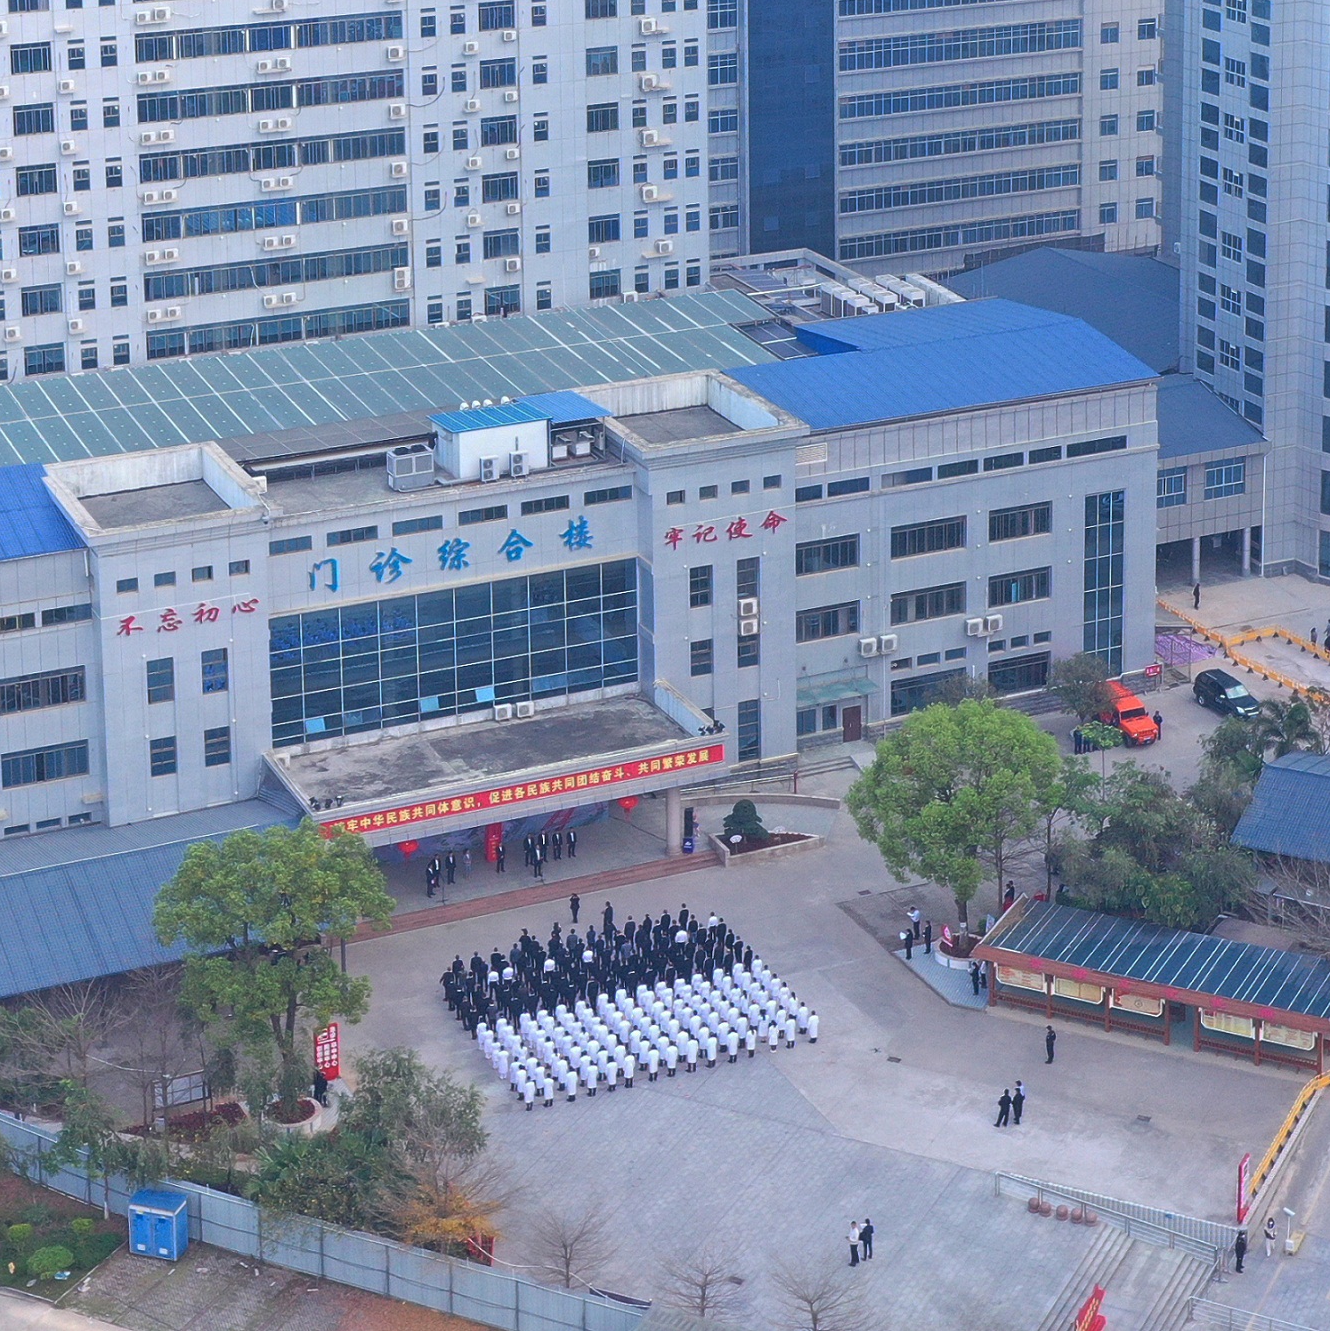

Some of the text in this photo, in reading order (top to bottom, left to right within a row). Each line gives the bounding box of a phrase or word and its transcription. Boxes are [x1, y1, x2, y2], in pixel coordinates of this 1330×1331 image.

[664, 509, 788, 551] 牢记使命
[307, 516, 594, 593] 门诊综合楼
[116, 597, 260, 636] 不忘初心
